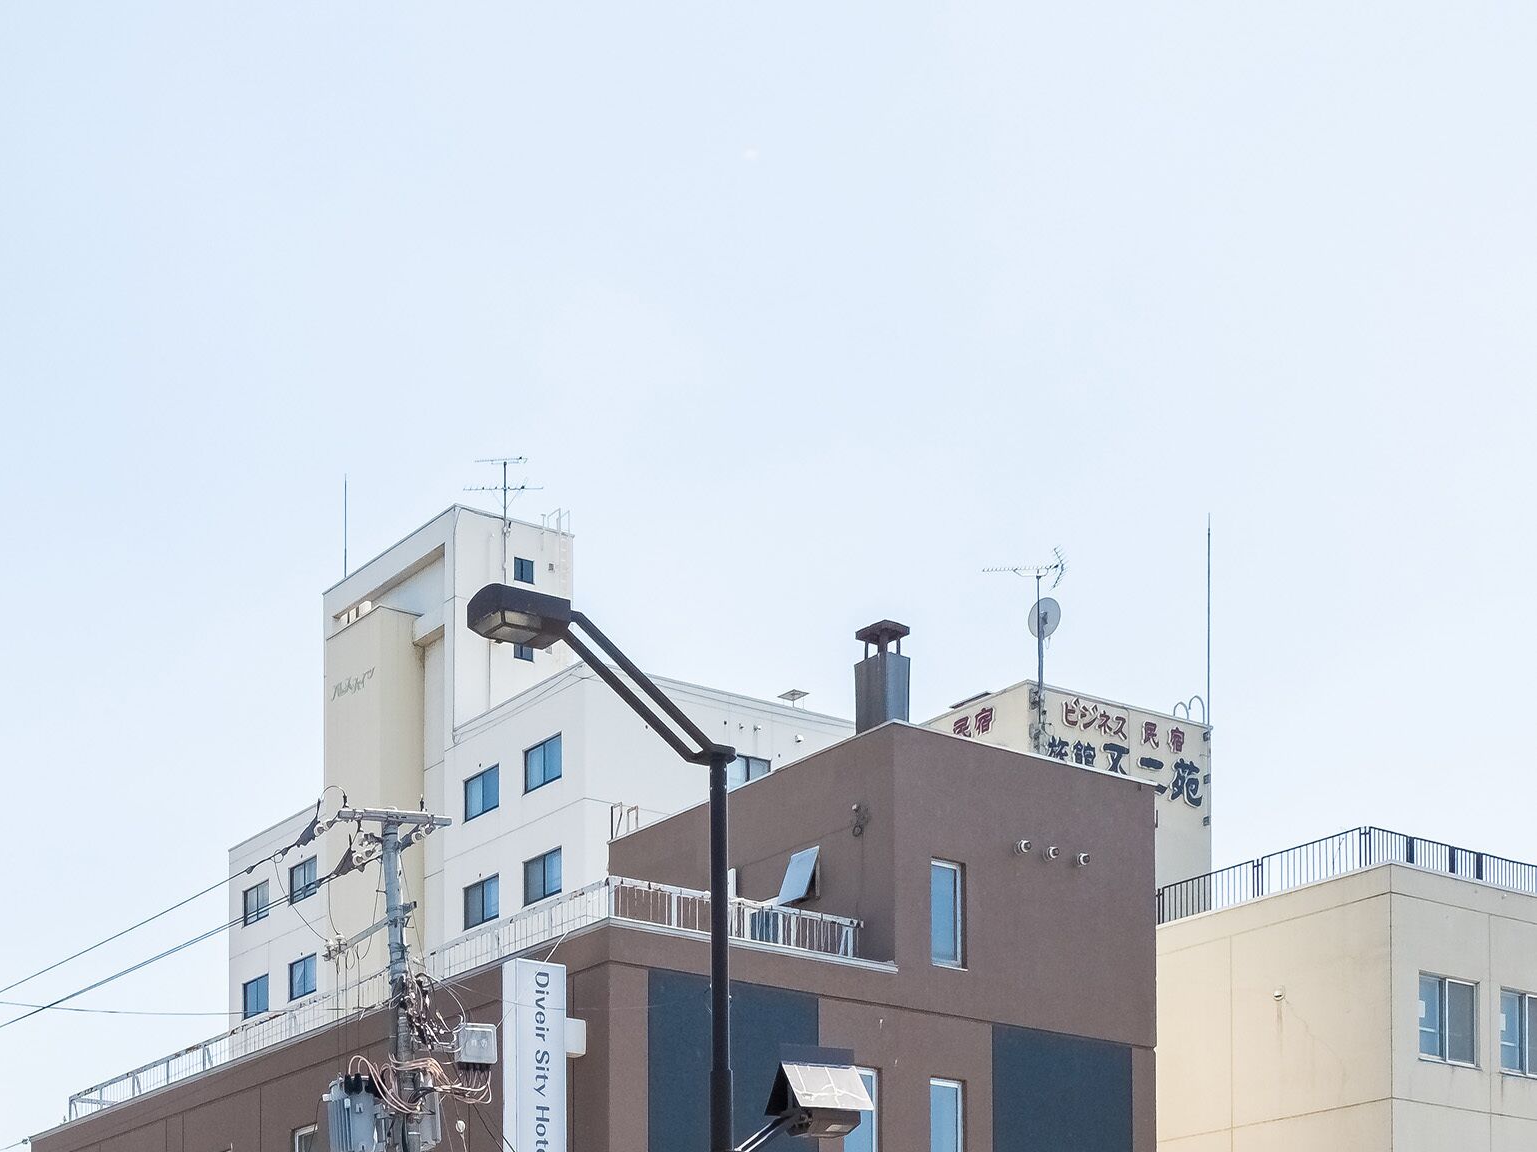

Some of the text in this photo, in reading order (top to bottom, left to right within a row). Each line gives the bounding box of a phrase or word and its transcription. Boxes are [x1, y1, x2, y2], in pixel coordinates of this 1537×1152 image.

[1061, 698, 1128, 741] ビジネス
[532, 1048, 550, 1097] Sity
